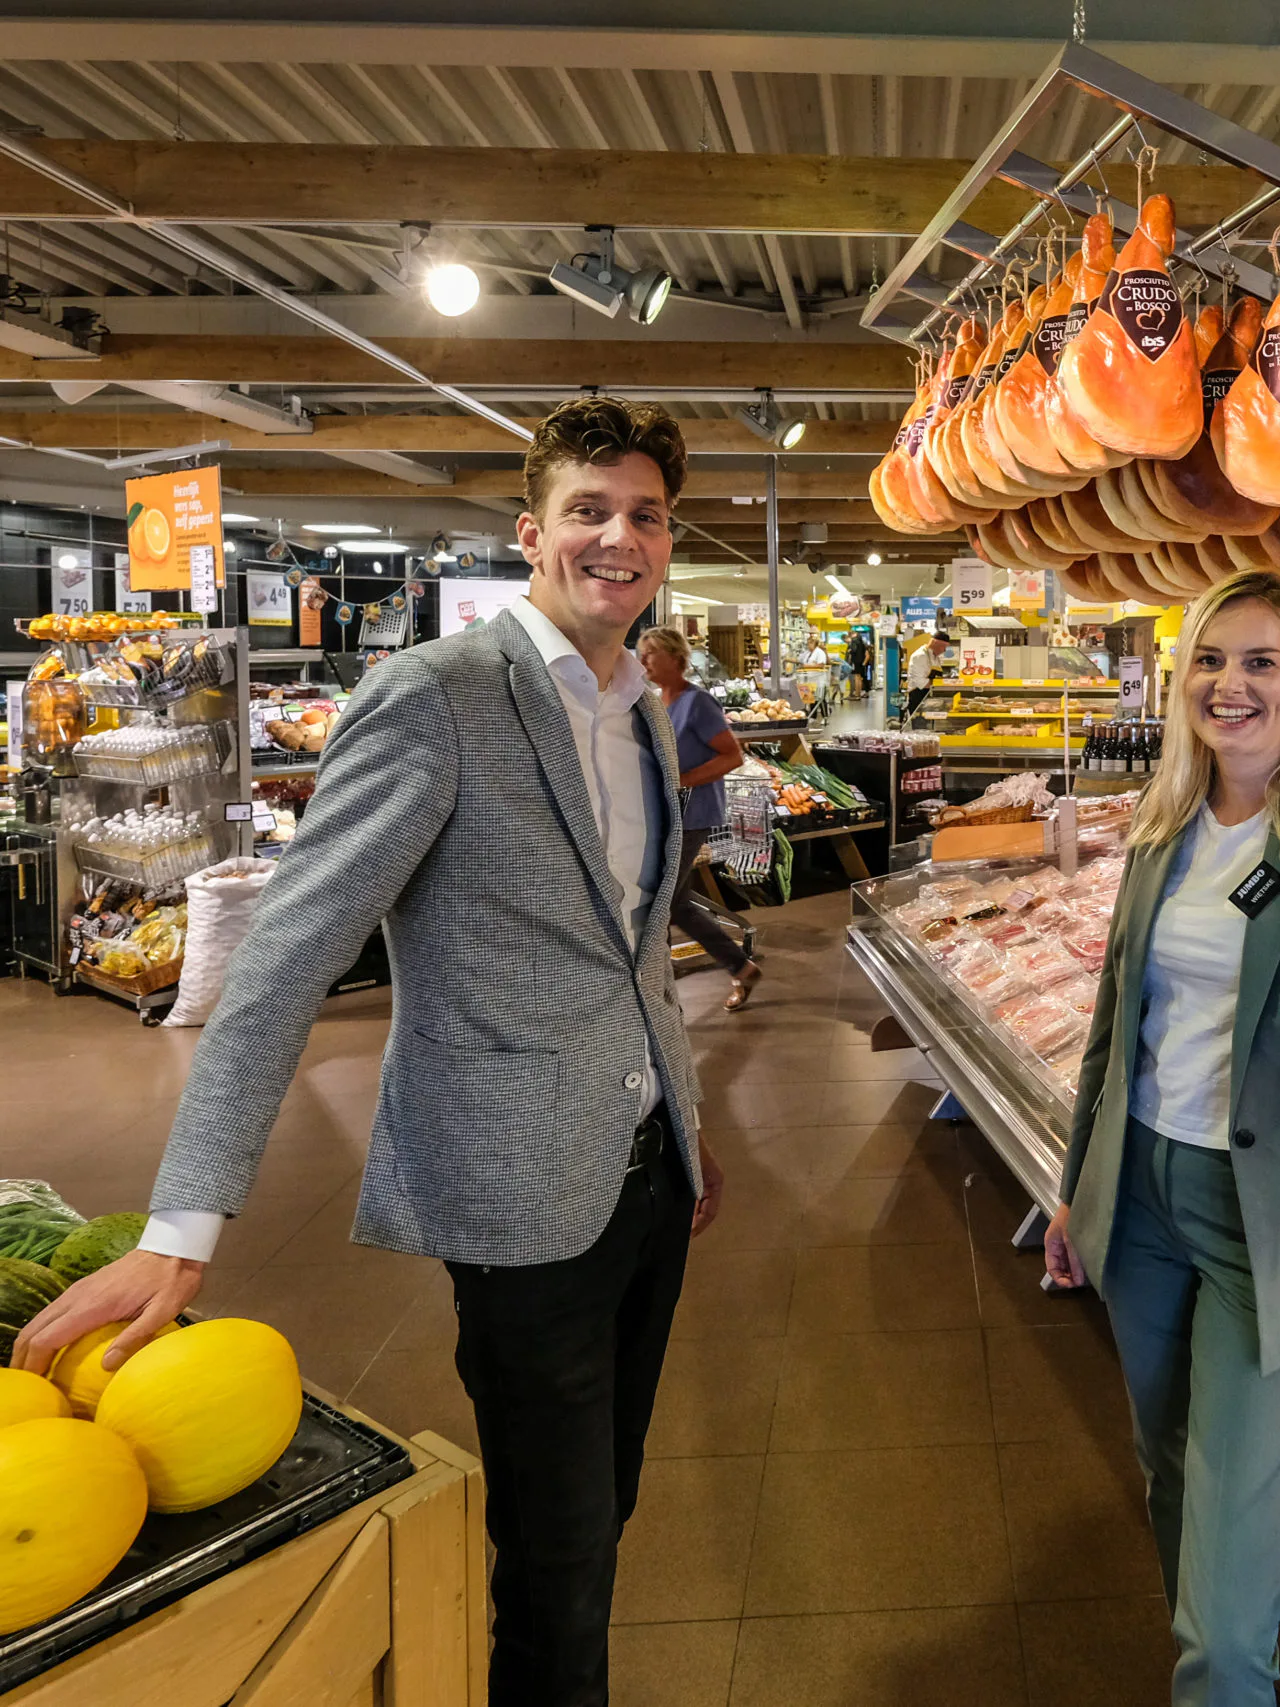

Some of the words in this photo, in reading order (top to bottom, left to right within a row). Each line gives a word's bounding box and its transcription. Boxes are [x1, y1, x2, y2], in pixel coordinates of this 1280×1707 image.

[1124, 277, 1170, 286] PROSCIUTTO
[1117, 286, 1177, 302] CRUDO
[1134, 301, 1171, 311] BOSCO
[1038, 329, 1064, 342] CRU
[1202, 385, 1229, 398] CRU
[960, 590, 985, 605] 599
[1122, 679, 1141, 696] 649
[1237, 869, 1265, 899] JUMBO
